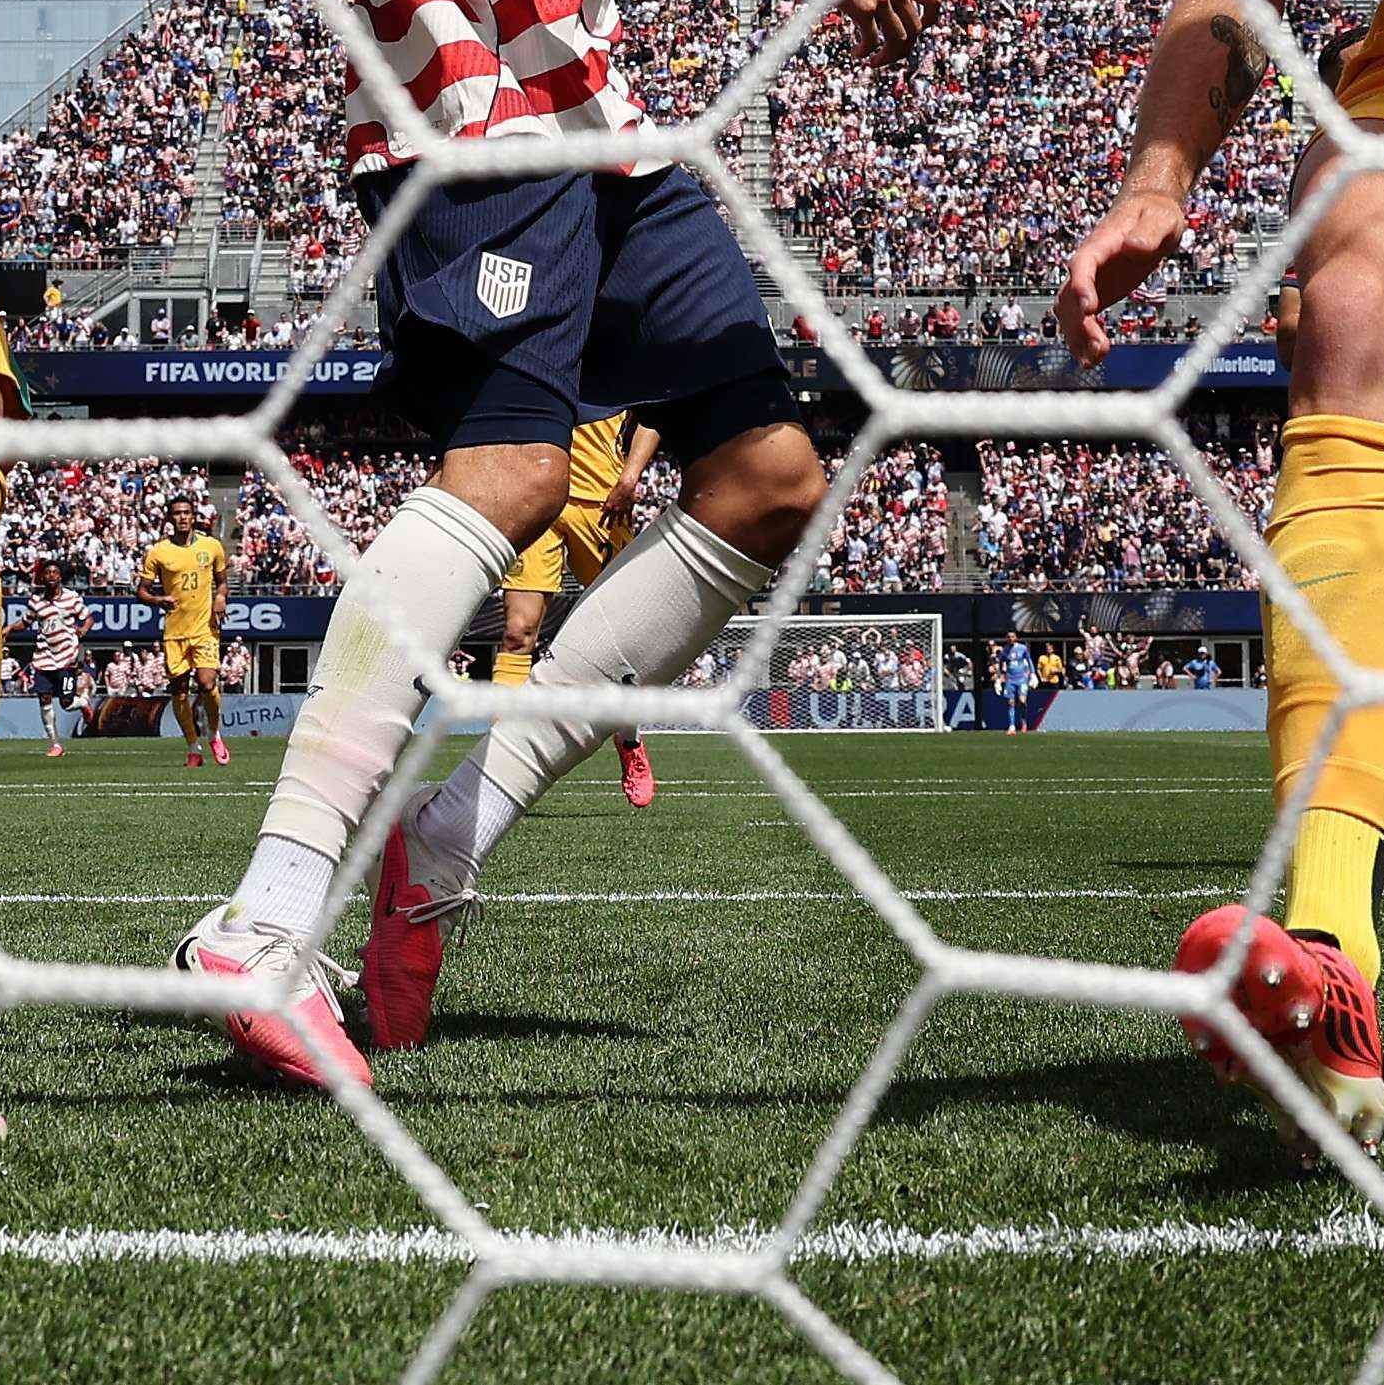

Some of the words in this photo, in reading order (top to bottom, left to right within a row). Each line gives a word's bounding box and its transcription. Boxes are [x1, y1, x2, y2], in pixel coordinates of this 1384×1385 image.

[485, 256, 528, 284] USA
[145, 361, 200, 383] FIFA
[181, 571, 199, 591] 23
[88, 603, 153, 631] CUP
[62, 676, 75, 691] 16
[221, 704, 285, 730] ULTRA
